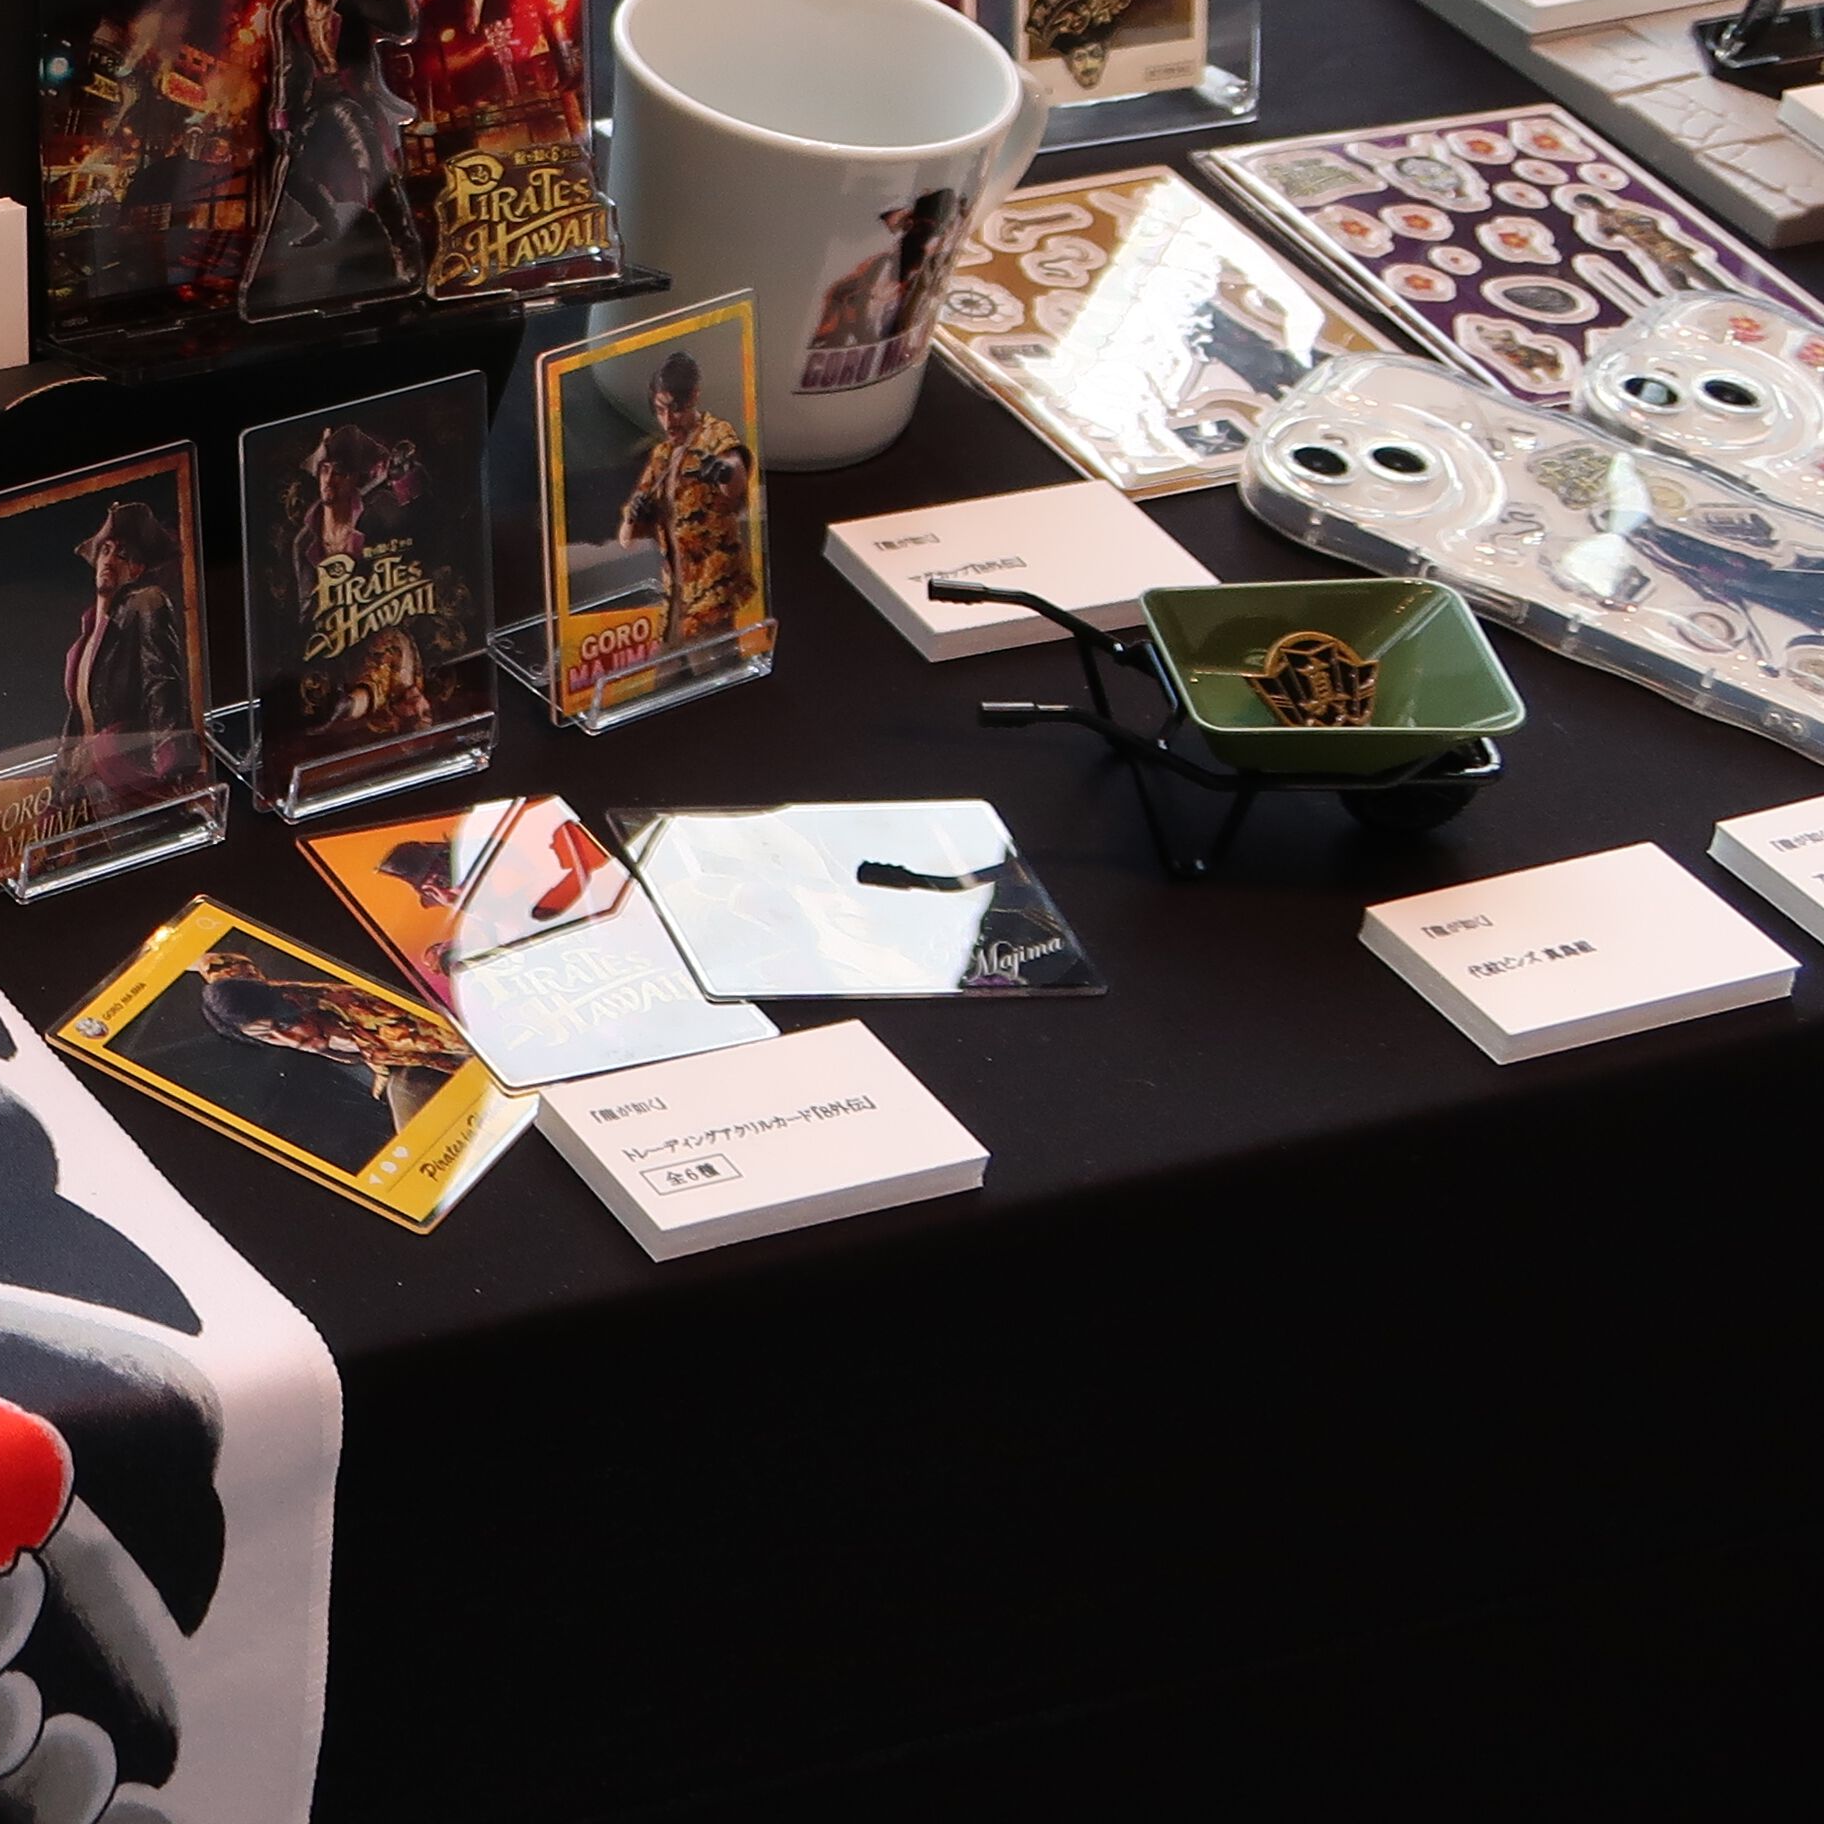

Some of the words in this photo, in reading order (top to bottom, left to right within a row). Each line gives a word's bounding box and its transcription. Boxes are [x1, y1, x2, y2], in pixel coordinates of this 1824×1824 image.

[444, 153, 593, 236] PIRATES
[312, 553, 423, 620] PIRATES
[580, 617, 652, 661] GORO
[967, 937, 1063, 986] Majima
